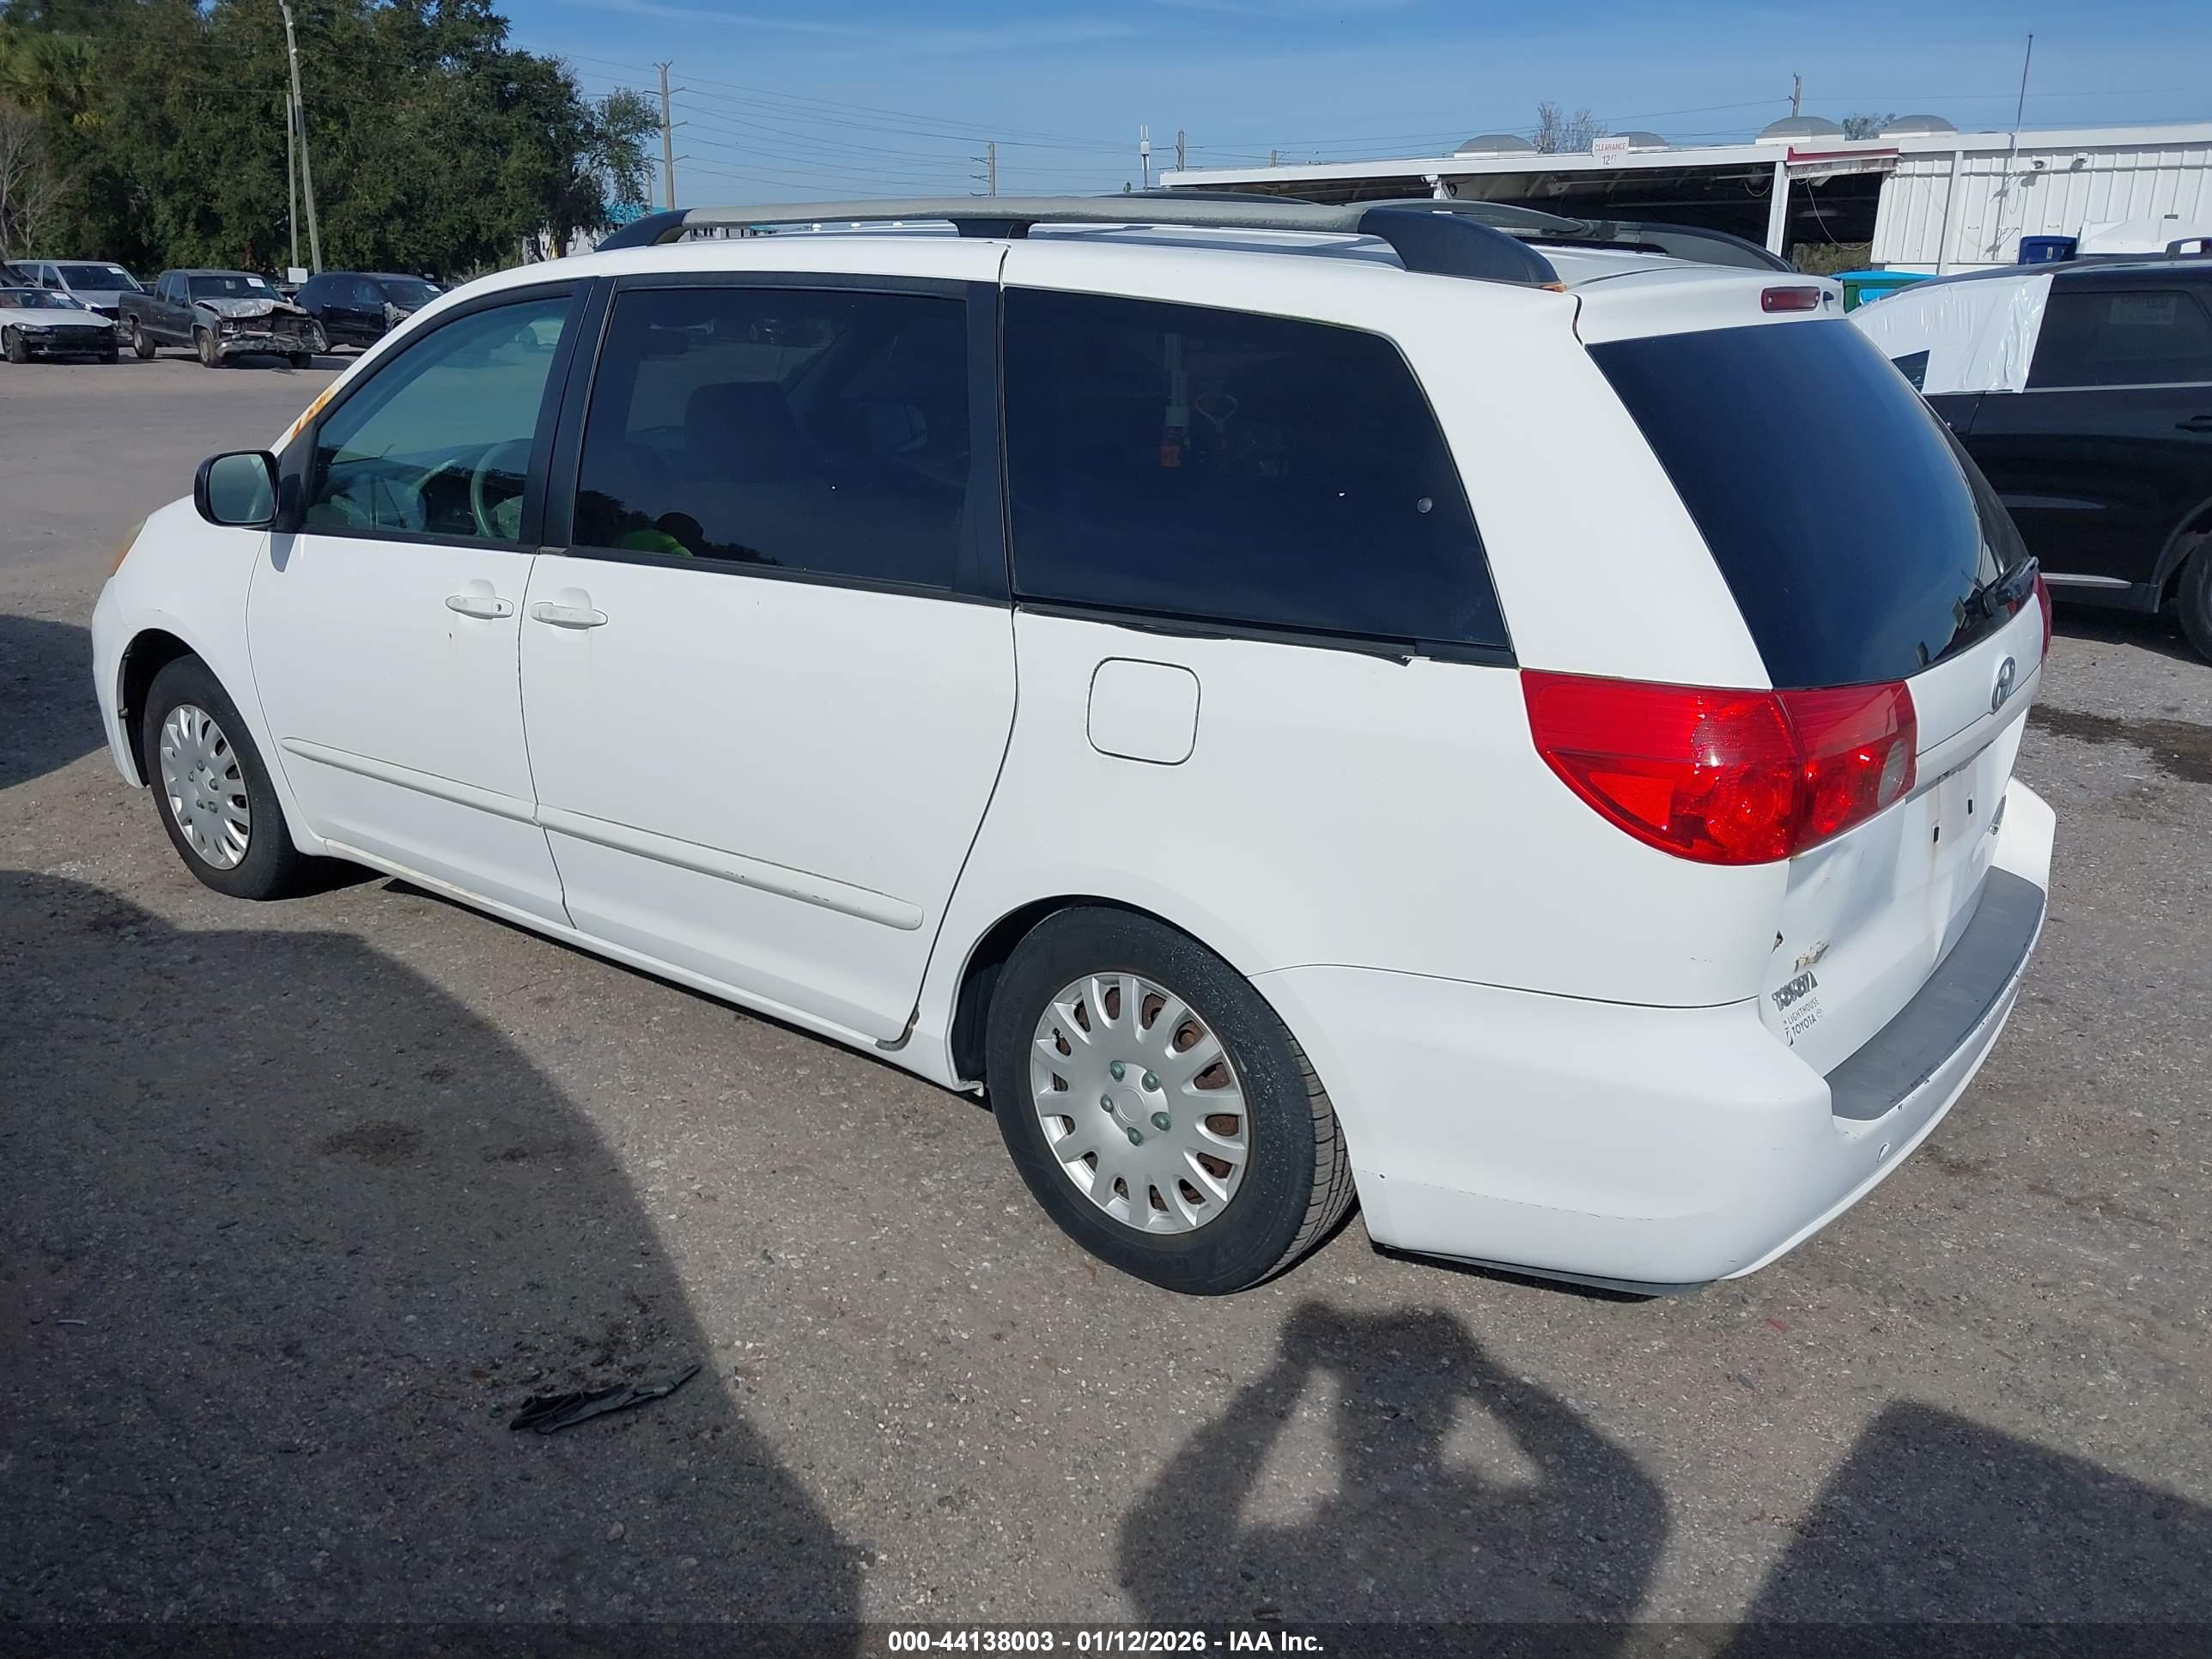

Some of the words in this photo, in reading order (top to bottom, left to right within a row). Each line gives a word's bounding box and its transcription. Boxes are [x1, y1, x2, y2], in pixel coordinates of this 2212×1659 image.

[1595, 143, 1626, 151] CLEARANCE
[1771, 970, 1819, 1012] TOYOTA
[1787, 996, 1820, 1024] LIGHTHOUSE
[1791, 1013, 1817, 1036] TOYOTA
